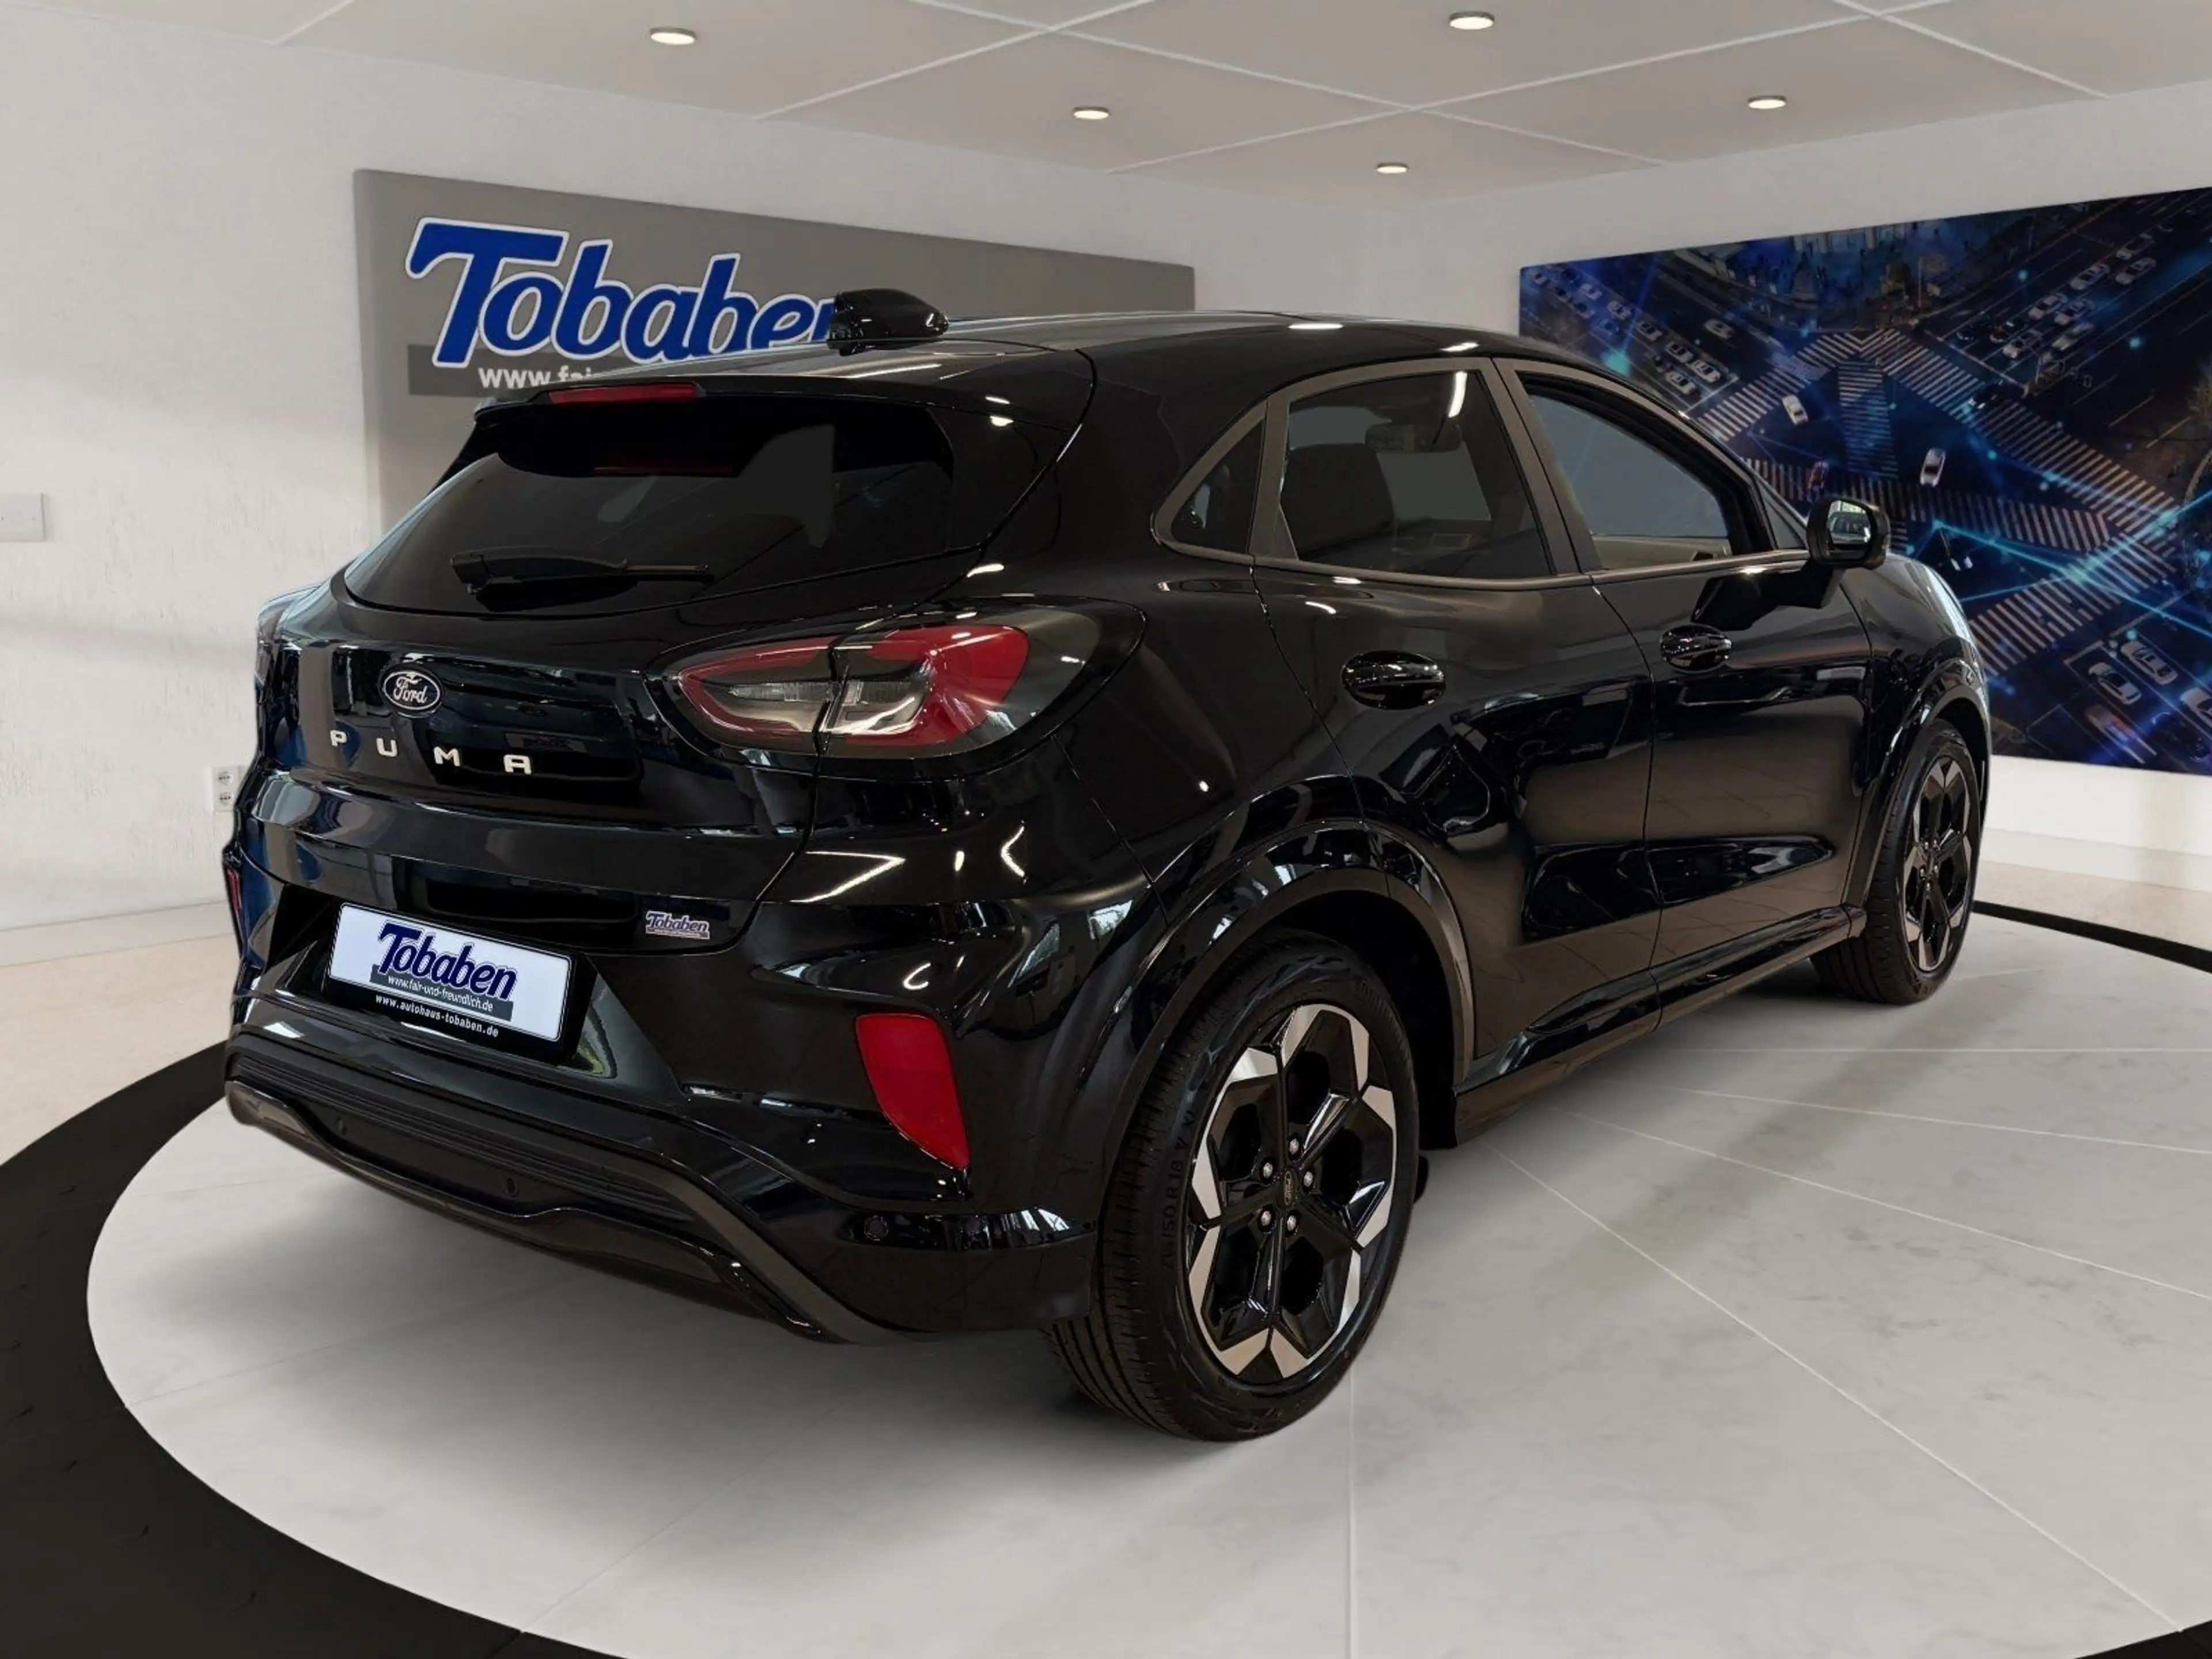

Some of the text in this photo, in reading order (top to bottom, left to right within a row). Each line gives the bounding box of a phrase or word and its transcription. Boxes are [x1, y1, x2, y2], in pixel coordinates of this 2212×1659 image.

[393, 675, 427, 704] Ford
[329, 729, 532, 775] PUMA
[646, 910, 709, 933] Tobaben
[378, 922, 517, 1000] Tobaben
[388, 974, 494, 1013] www.fair-und-freundlich.de
[375, 994, 499, 1038] www.autohaus-tobaben.de
